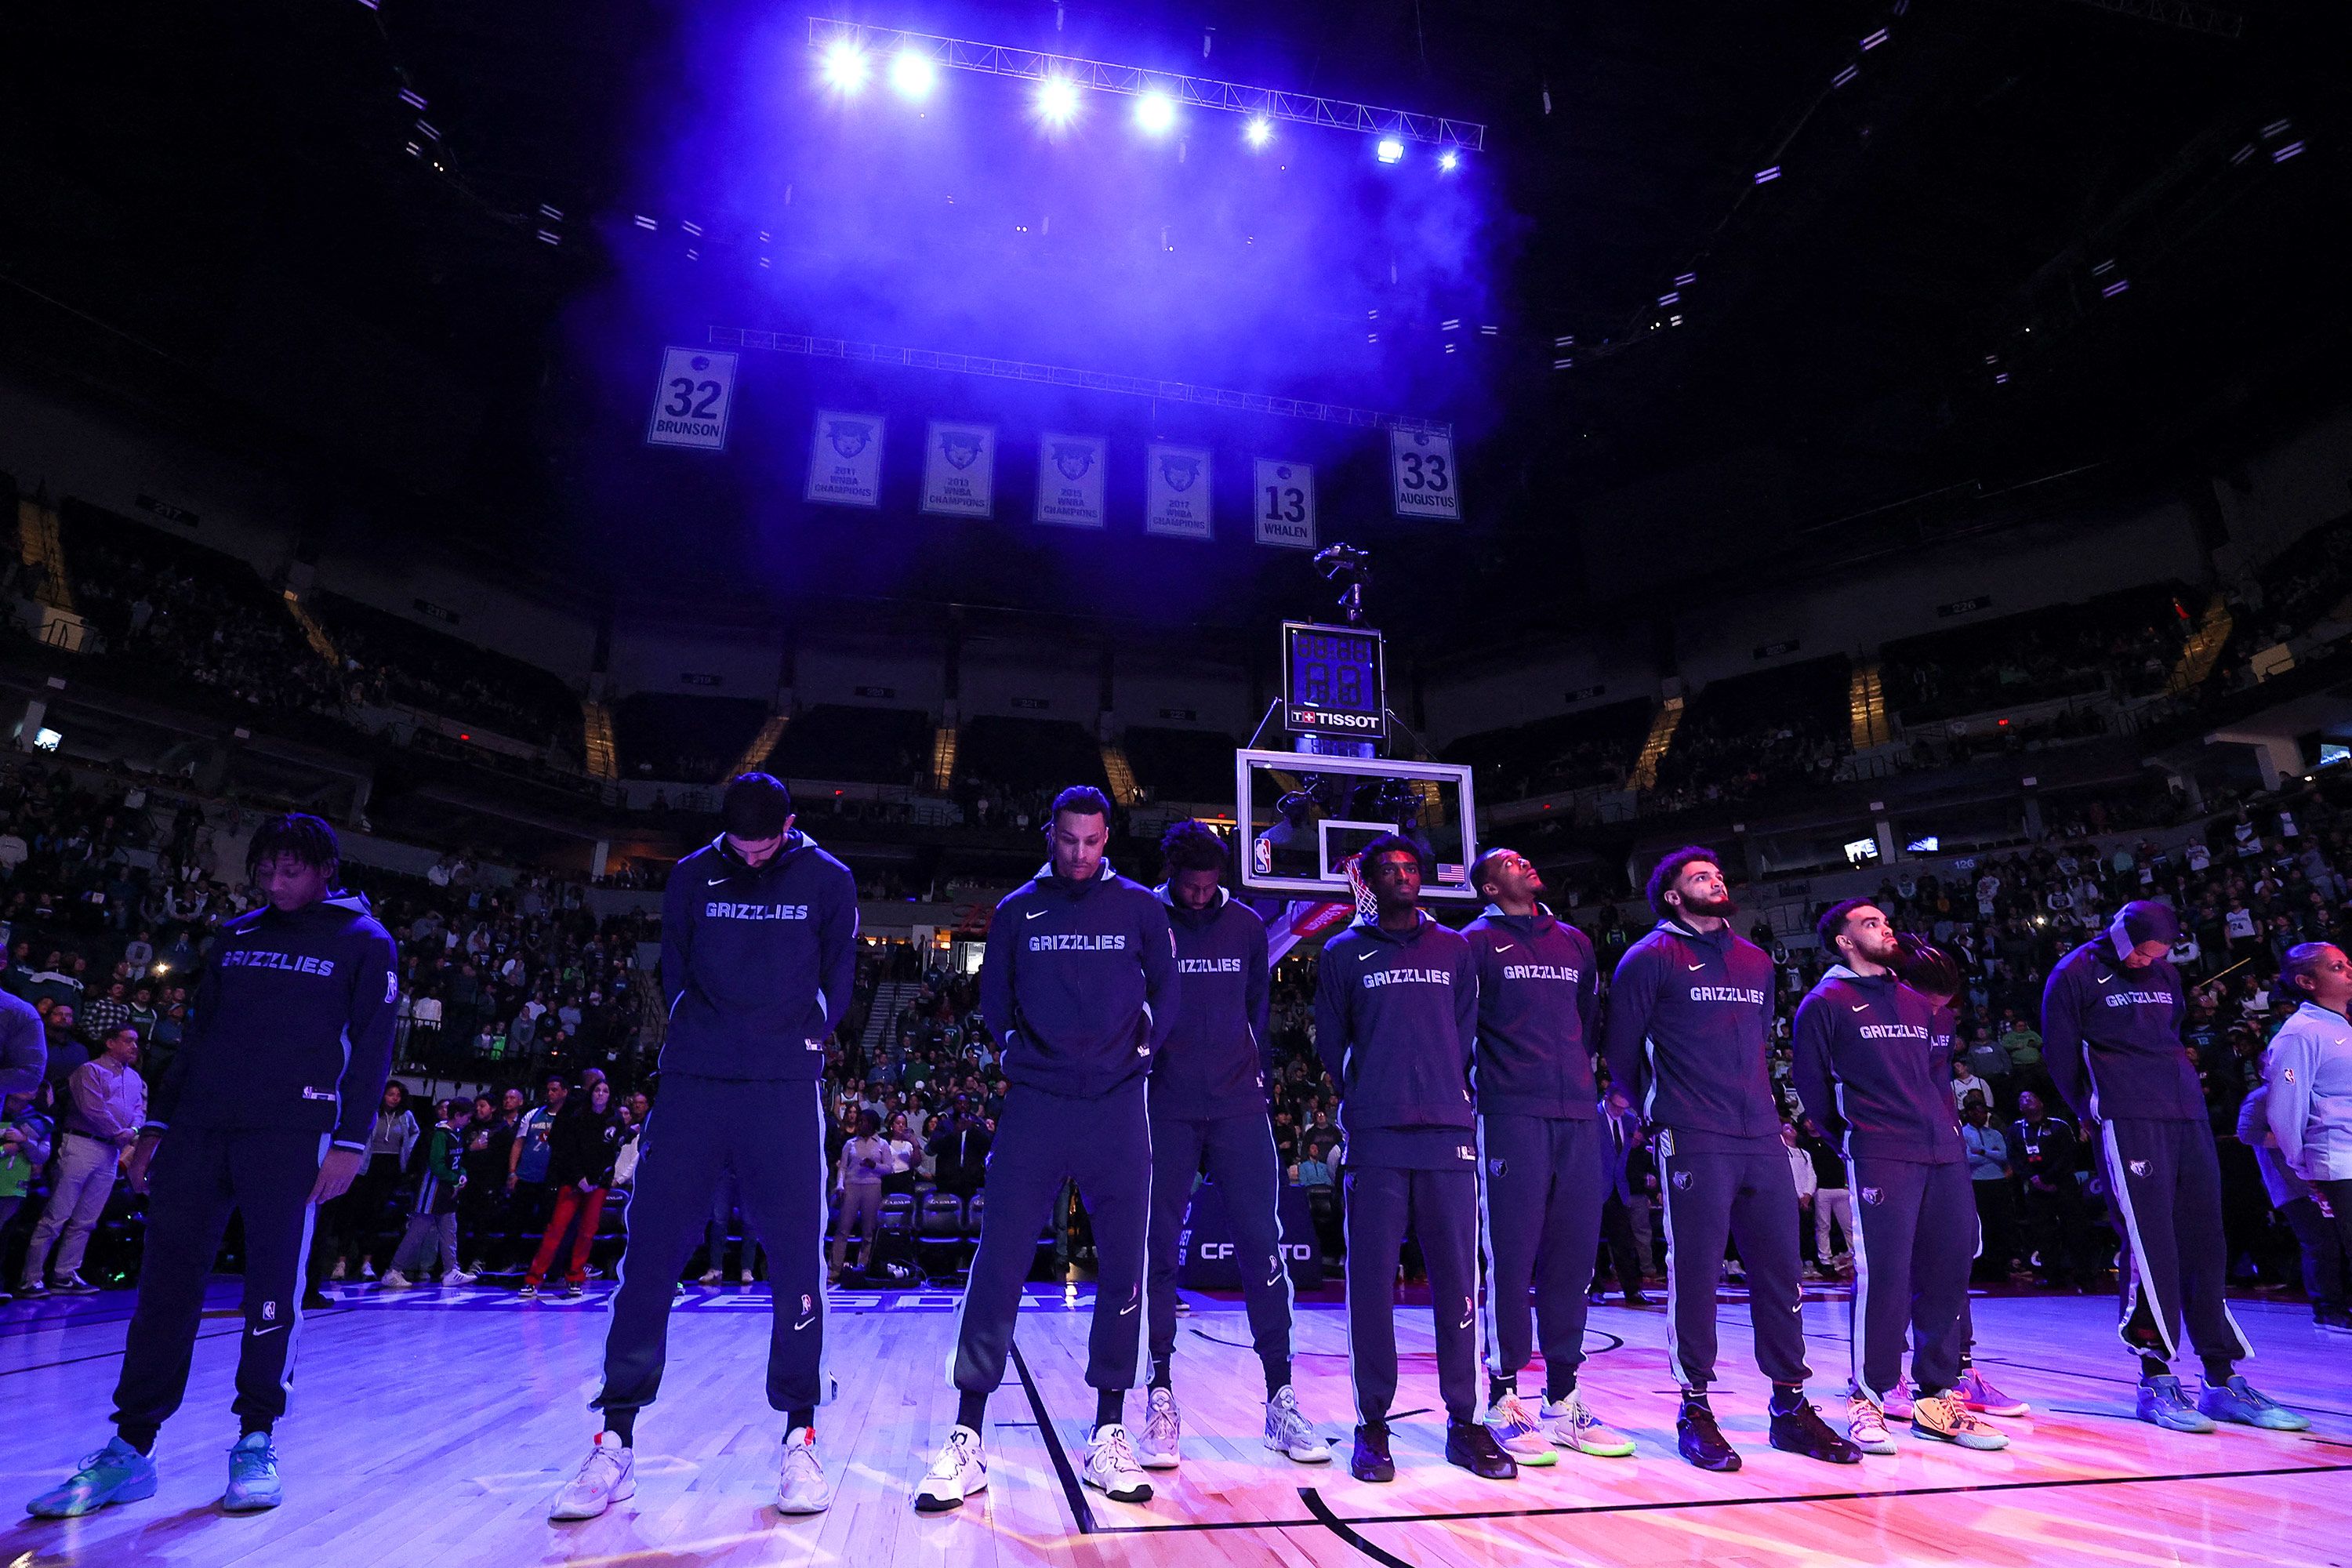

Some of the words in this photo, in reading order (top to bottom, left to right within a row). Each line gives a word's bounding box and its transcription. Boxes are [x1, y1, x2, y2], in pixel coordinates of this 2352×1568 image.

[665, 377, 722, 419] 32
[655, 419, 719, 437] BRUNSON
[829, 475, 858, 485] WNBA
[1401, 452, 1448, 492] 33
[947, 477, 969, 486] 2013
[814, 483, 873, 497] CHAMPIONS
[943, 485, 971, 496] WNBA
[1060, 488, 1083, 498] 2015
[928, 495, 985, 508] CHAMPIONS
[1057, 496, 1085, 507] WNBA
[1265, 485, 1305, 523] 13
[1399, 493, 1455, 508] AUGUSTUS
[1043, 504, 1099, 518] CHAMPIONS
[1166, 508, 1192, 519] WNBA
[1152, 517, 1206, 529] CHAMPIONS
[1264, 523, 1308, 538] WHALEN
[1316, 712, 1380, 729] TISSOT
[1954, 858, 1975, 869] 126
[706, 902, 808, 920] GRIZZLIES
[1029, 934, 1126, 952] GRIZZLIES
[1178, 957, 1241, 974] IZZLIES
[1504, 964, 1579, 983] GRIZZLIES
[1363, 968, 1450, 989] GRIZZLIES
[1690, 986, 1765, 1005] GRIZZLIES
[2105, 990, 2173, 1007] GRIZZLIES
[1201, 1243, 1311, 1261] CFTO
